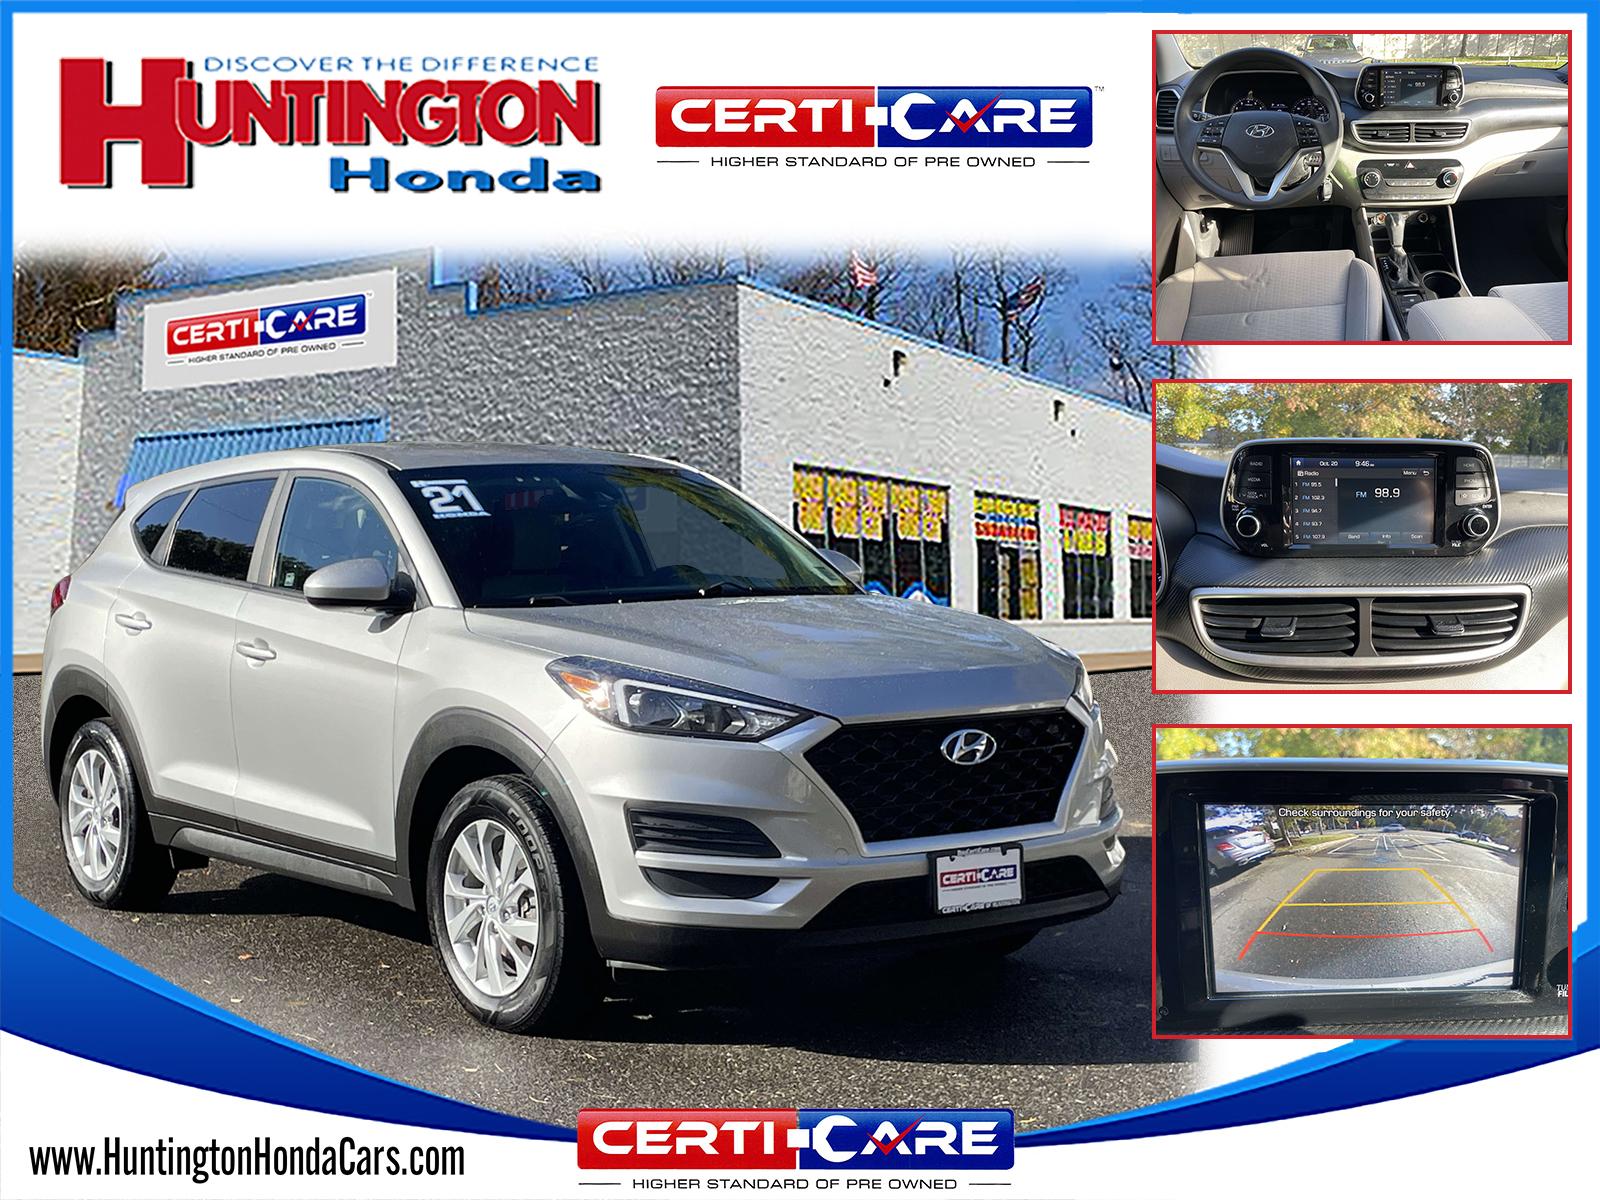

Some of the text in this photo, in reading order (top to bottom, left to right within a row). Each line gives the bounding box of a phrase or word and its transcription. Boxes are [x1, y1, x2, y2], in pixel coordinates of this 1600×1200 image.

[219, 349, 266, 361] STANDARD
[266, 347, 279, 356] OF
[300, 342, 337, 354] OWNED
[421, 485, 485, 514] 21
[1374, 487, 1401, 498] 98.9
[1278, 807, 1310, 817] Check
[1311, 807, 1377, 819] surroundings
[1378, 807, 1394, 817] for
[1395, 809, 1418, 819] your
